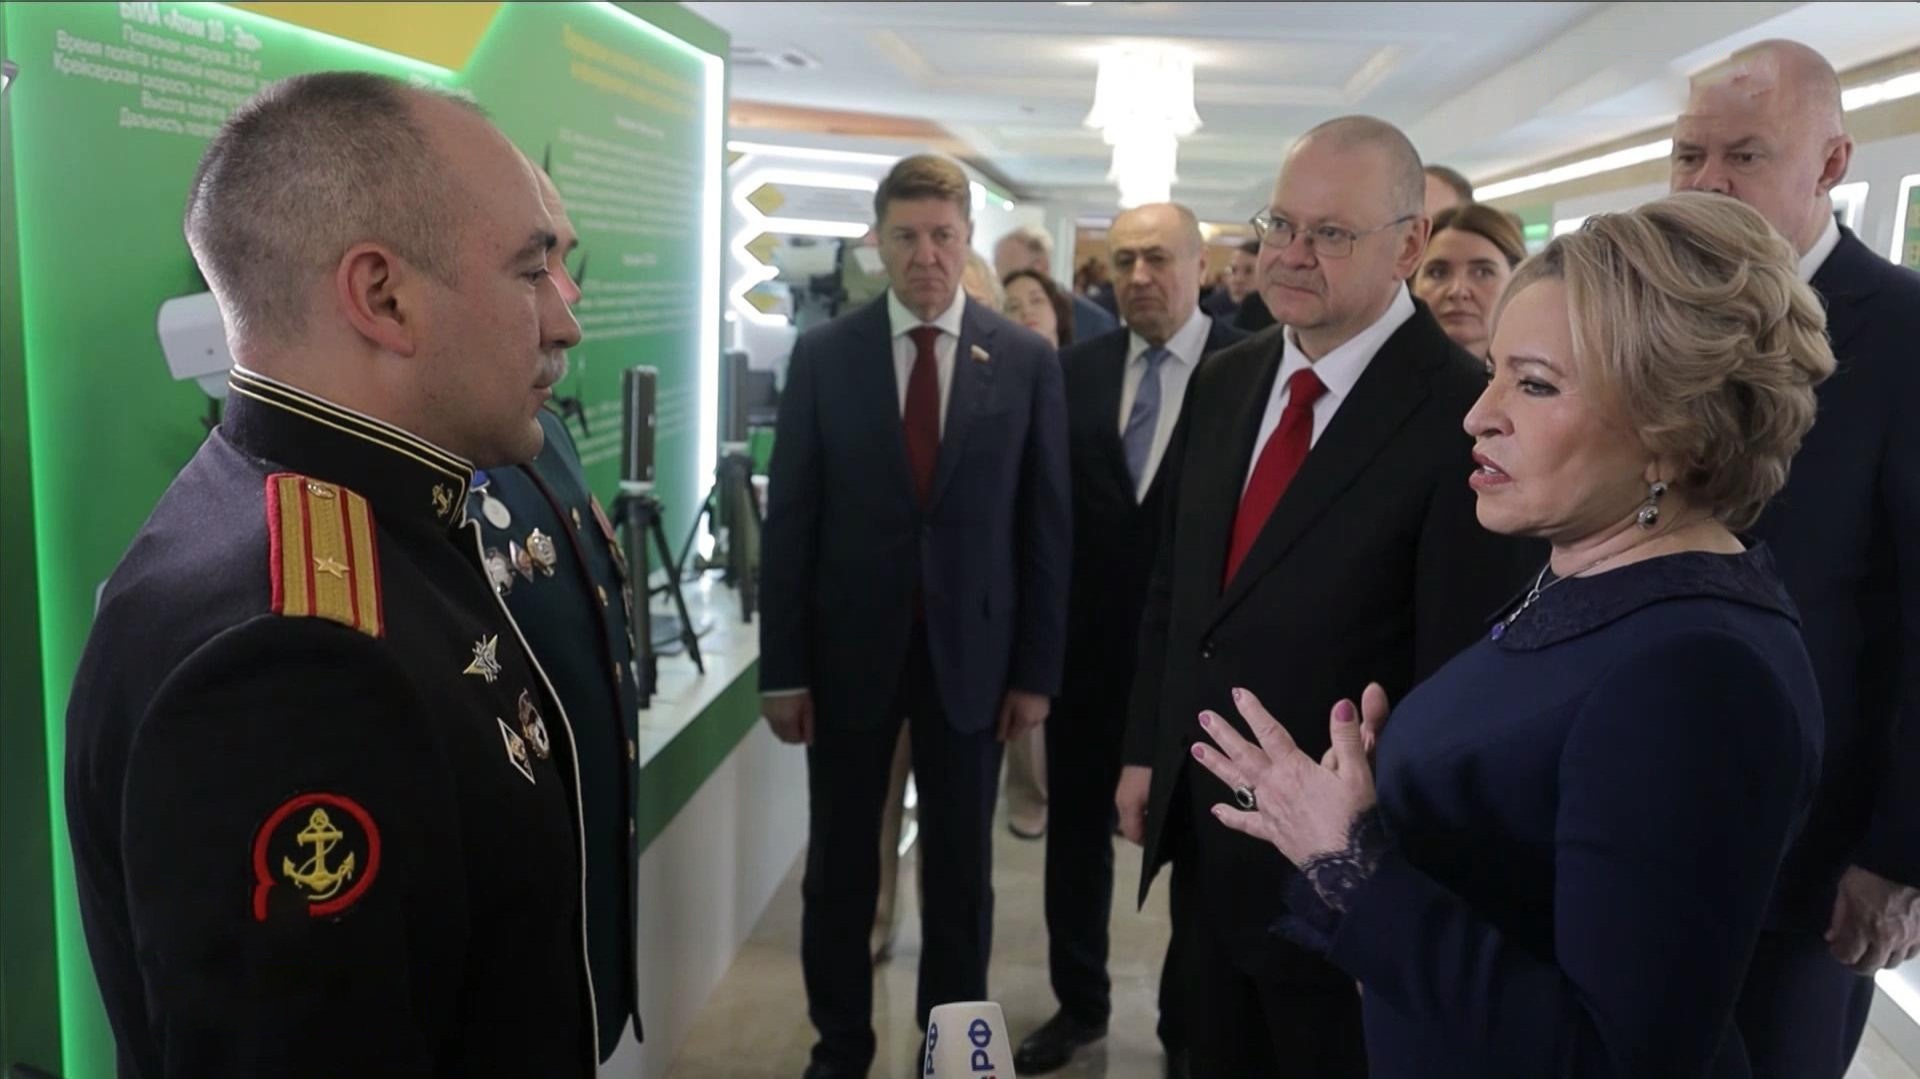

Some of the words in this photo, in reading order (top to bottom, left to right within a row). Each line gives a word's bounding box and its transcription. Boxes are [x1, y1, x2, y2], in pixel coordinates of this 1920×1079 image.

[56, 28, 103, 55] Время
[53, 51, 139, 85] Крейсерская
[142, 74, 192, 95] скорость
[141, 89, 186, 114] Высота
[120, 106, 184, 134] Дальность
[968, 1018, 995, 1071] РФ
